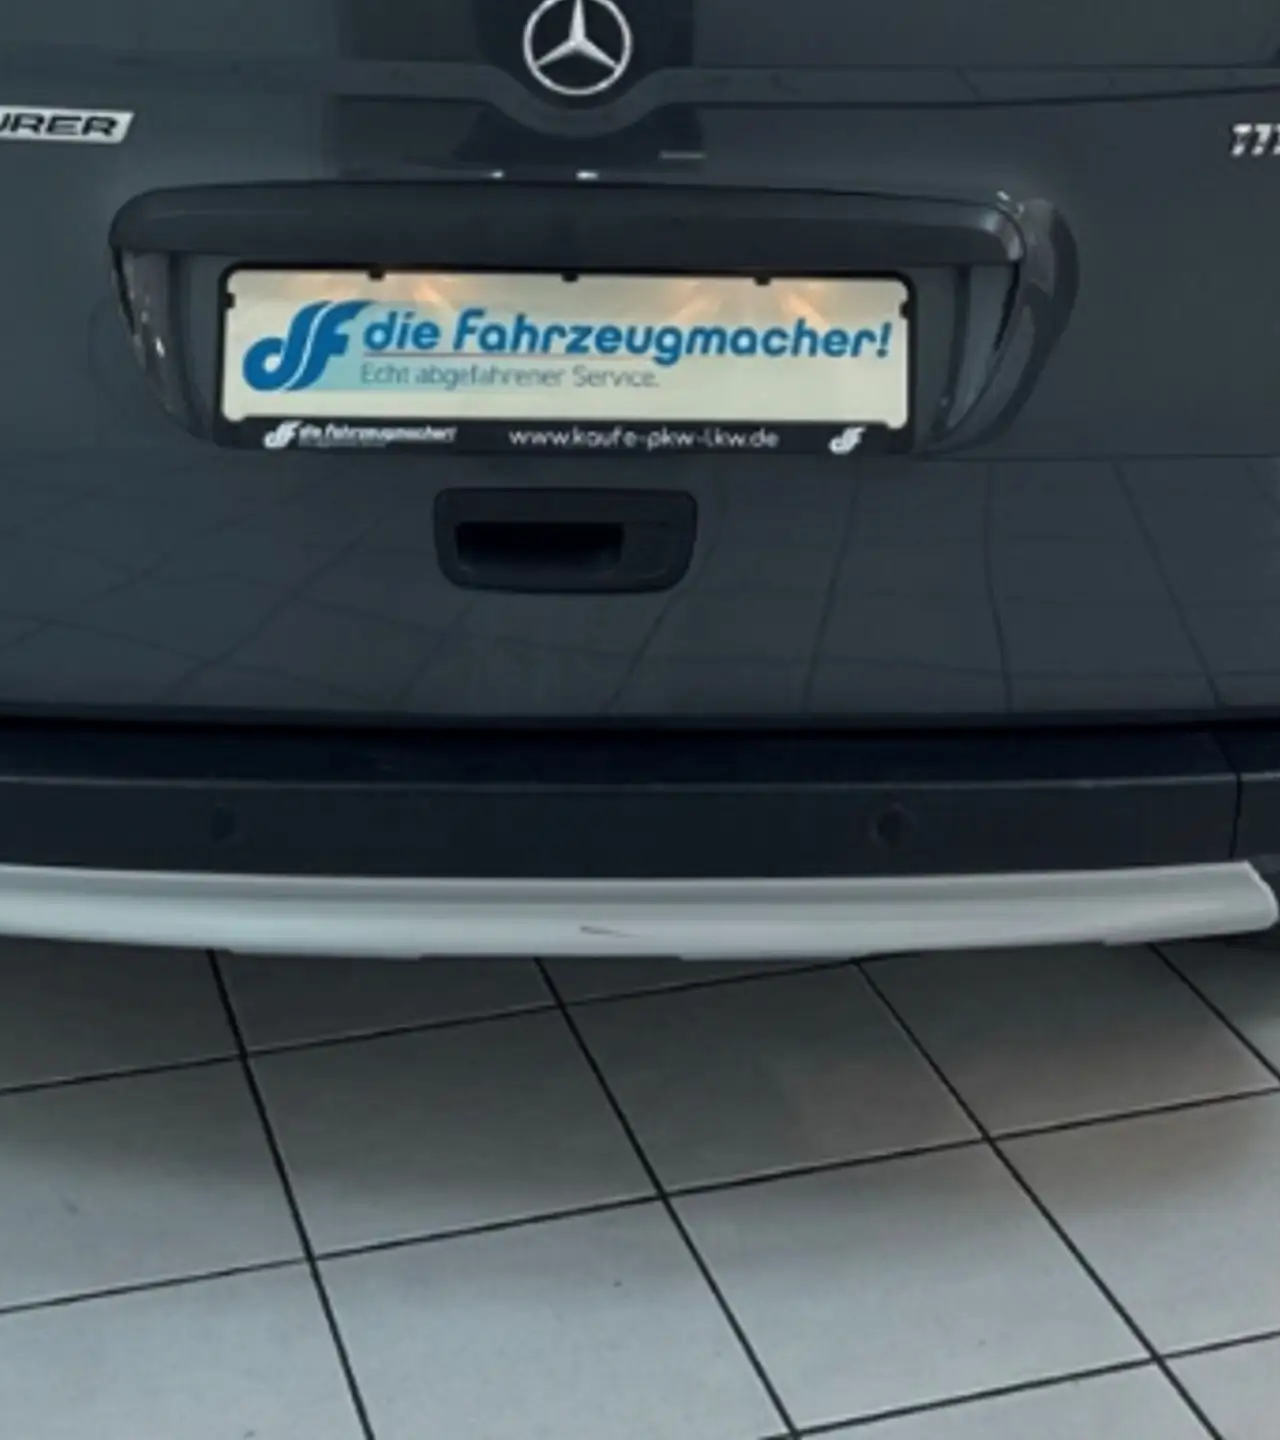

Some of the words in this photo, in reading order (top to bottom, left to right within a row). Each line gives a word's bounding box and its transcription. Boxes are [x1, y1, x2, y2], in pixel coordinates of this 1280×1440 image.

[363, 310, 440, 351] die
[453, 308, 892, 366] Fahrzeugmacher!
[360, 362, 409, 385] Echt
[415, 363, 566, 390] abgefahrener
[573, 364, 659, 388] Service.
[509, 424, 779, 450] www.kaufe-pkw-lkw.de
